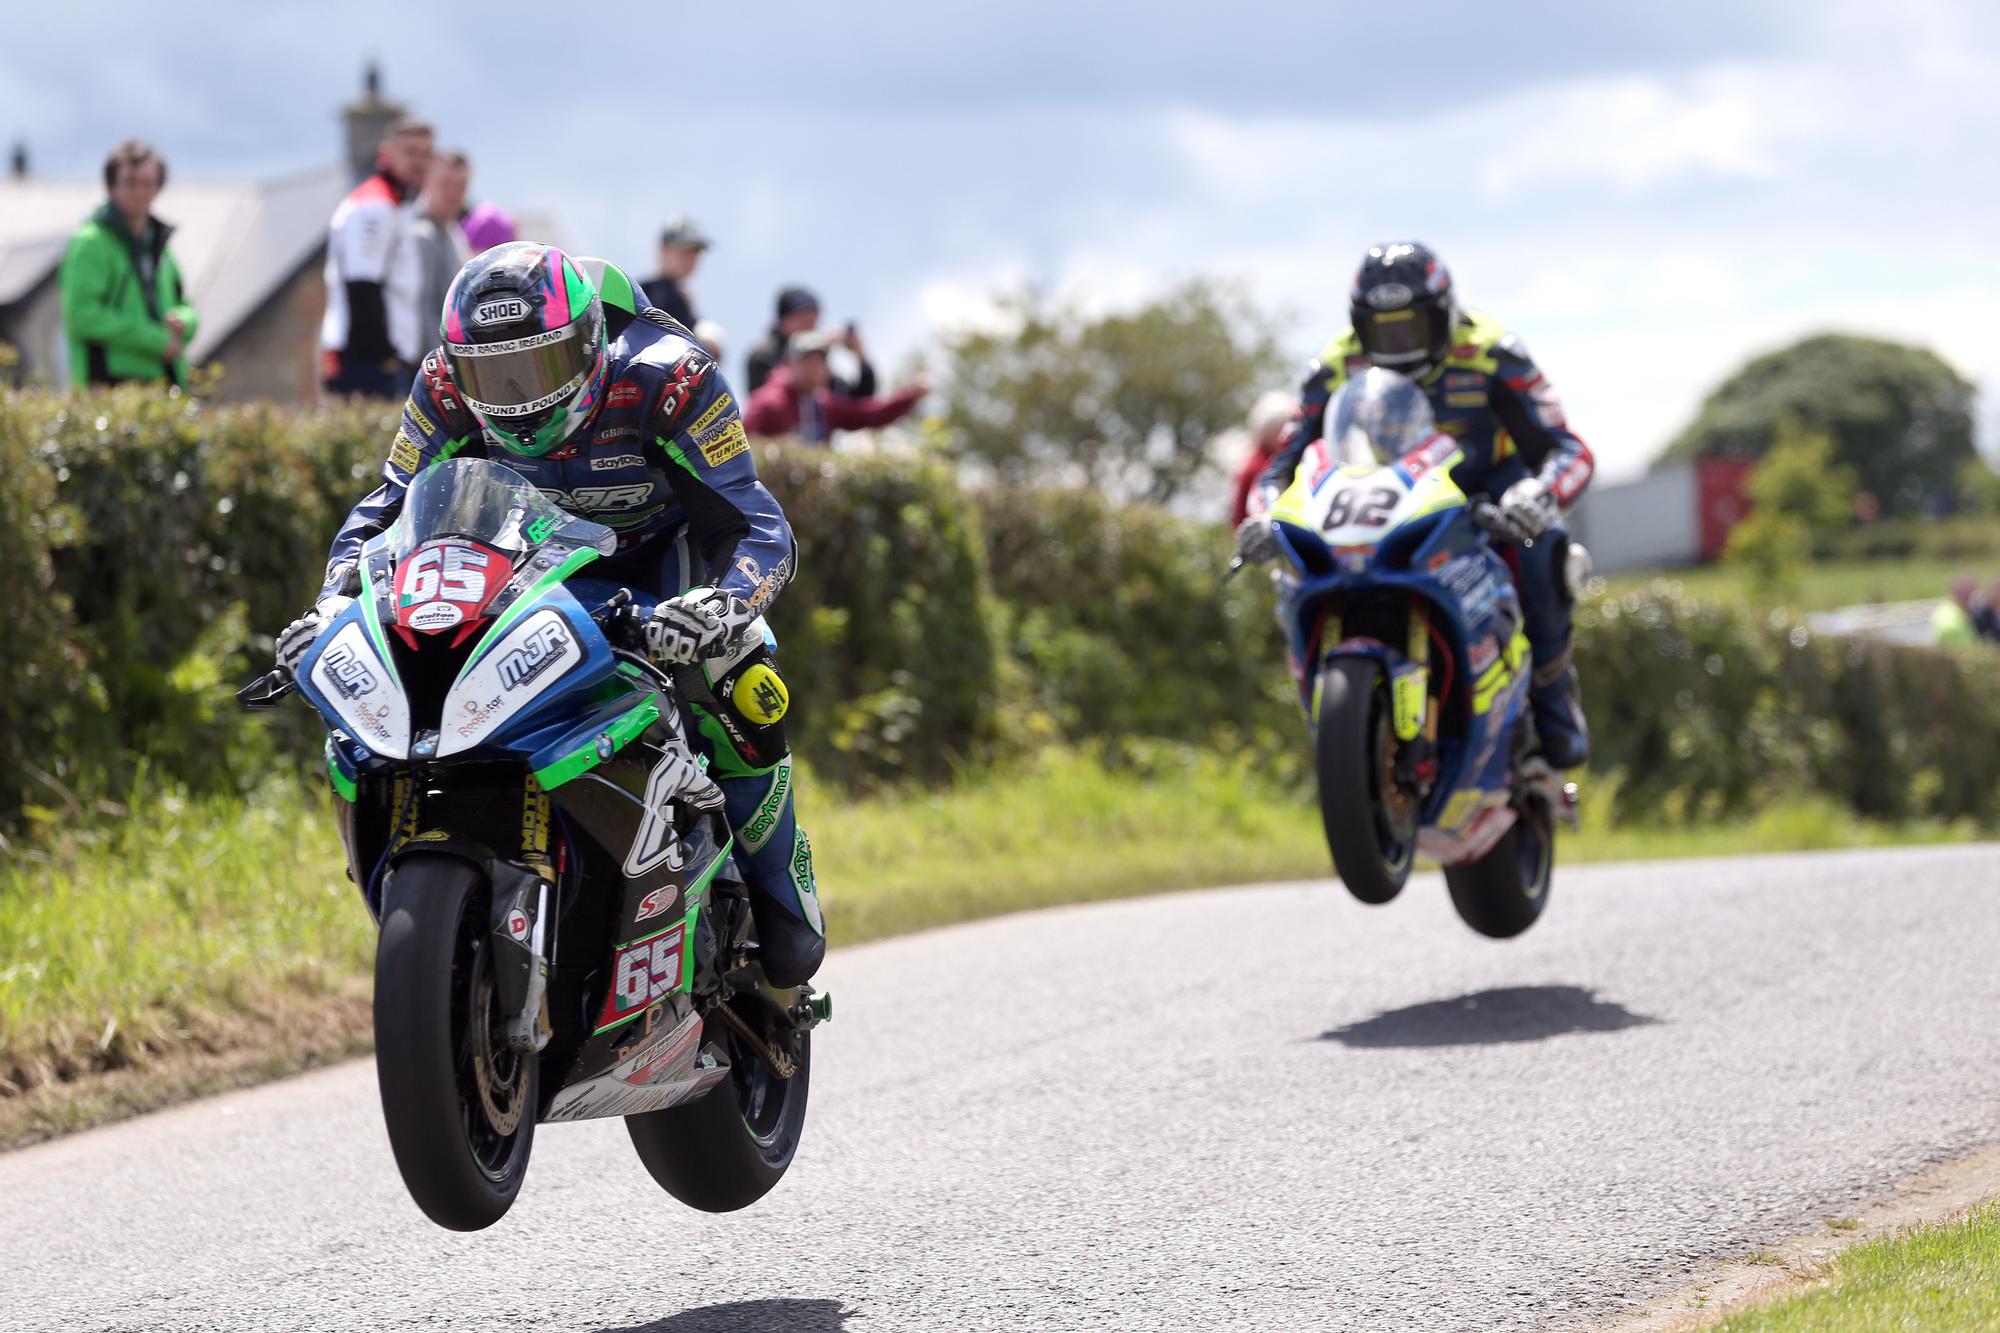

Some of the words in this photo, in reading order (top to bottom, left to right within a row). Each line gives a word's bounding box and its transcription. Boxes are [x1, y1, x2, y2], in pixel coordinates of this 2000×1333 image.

[480, 303, 522, 321] SHOEI
[478, 341, 517, 354] RACING
[518, 331, 562, 349] IRELAND
[472, 402, 517, 415] AROUND
[519, 404, 529, 413] A
[532, 385, 571, 409] POUND
[695, 395, 728, 428] DUNLOP
[595, 455, 645, 470] daytona
[1322, 487, 1400, 531] 82
[400, 546, 489, 609] 65
[416, 612, 455, 621] Walton
[323, 643, 378, 700] MJR
[496, 620, 569, 692] MJR
[458, 695, 502, 737] Roadstar
[744, 766, 789, 843] daytona
[616, 930, 682, 1011] 65
